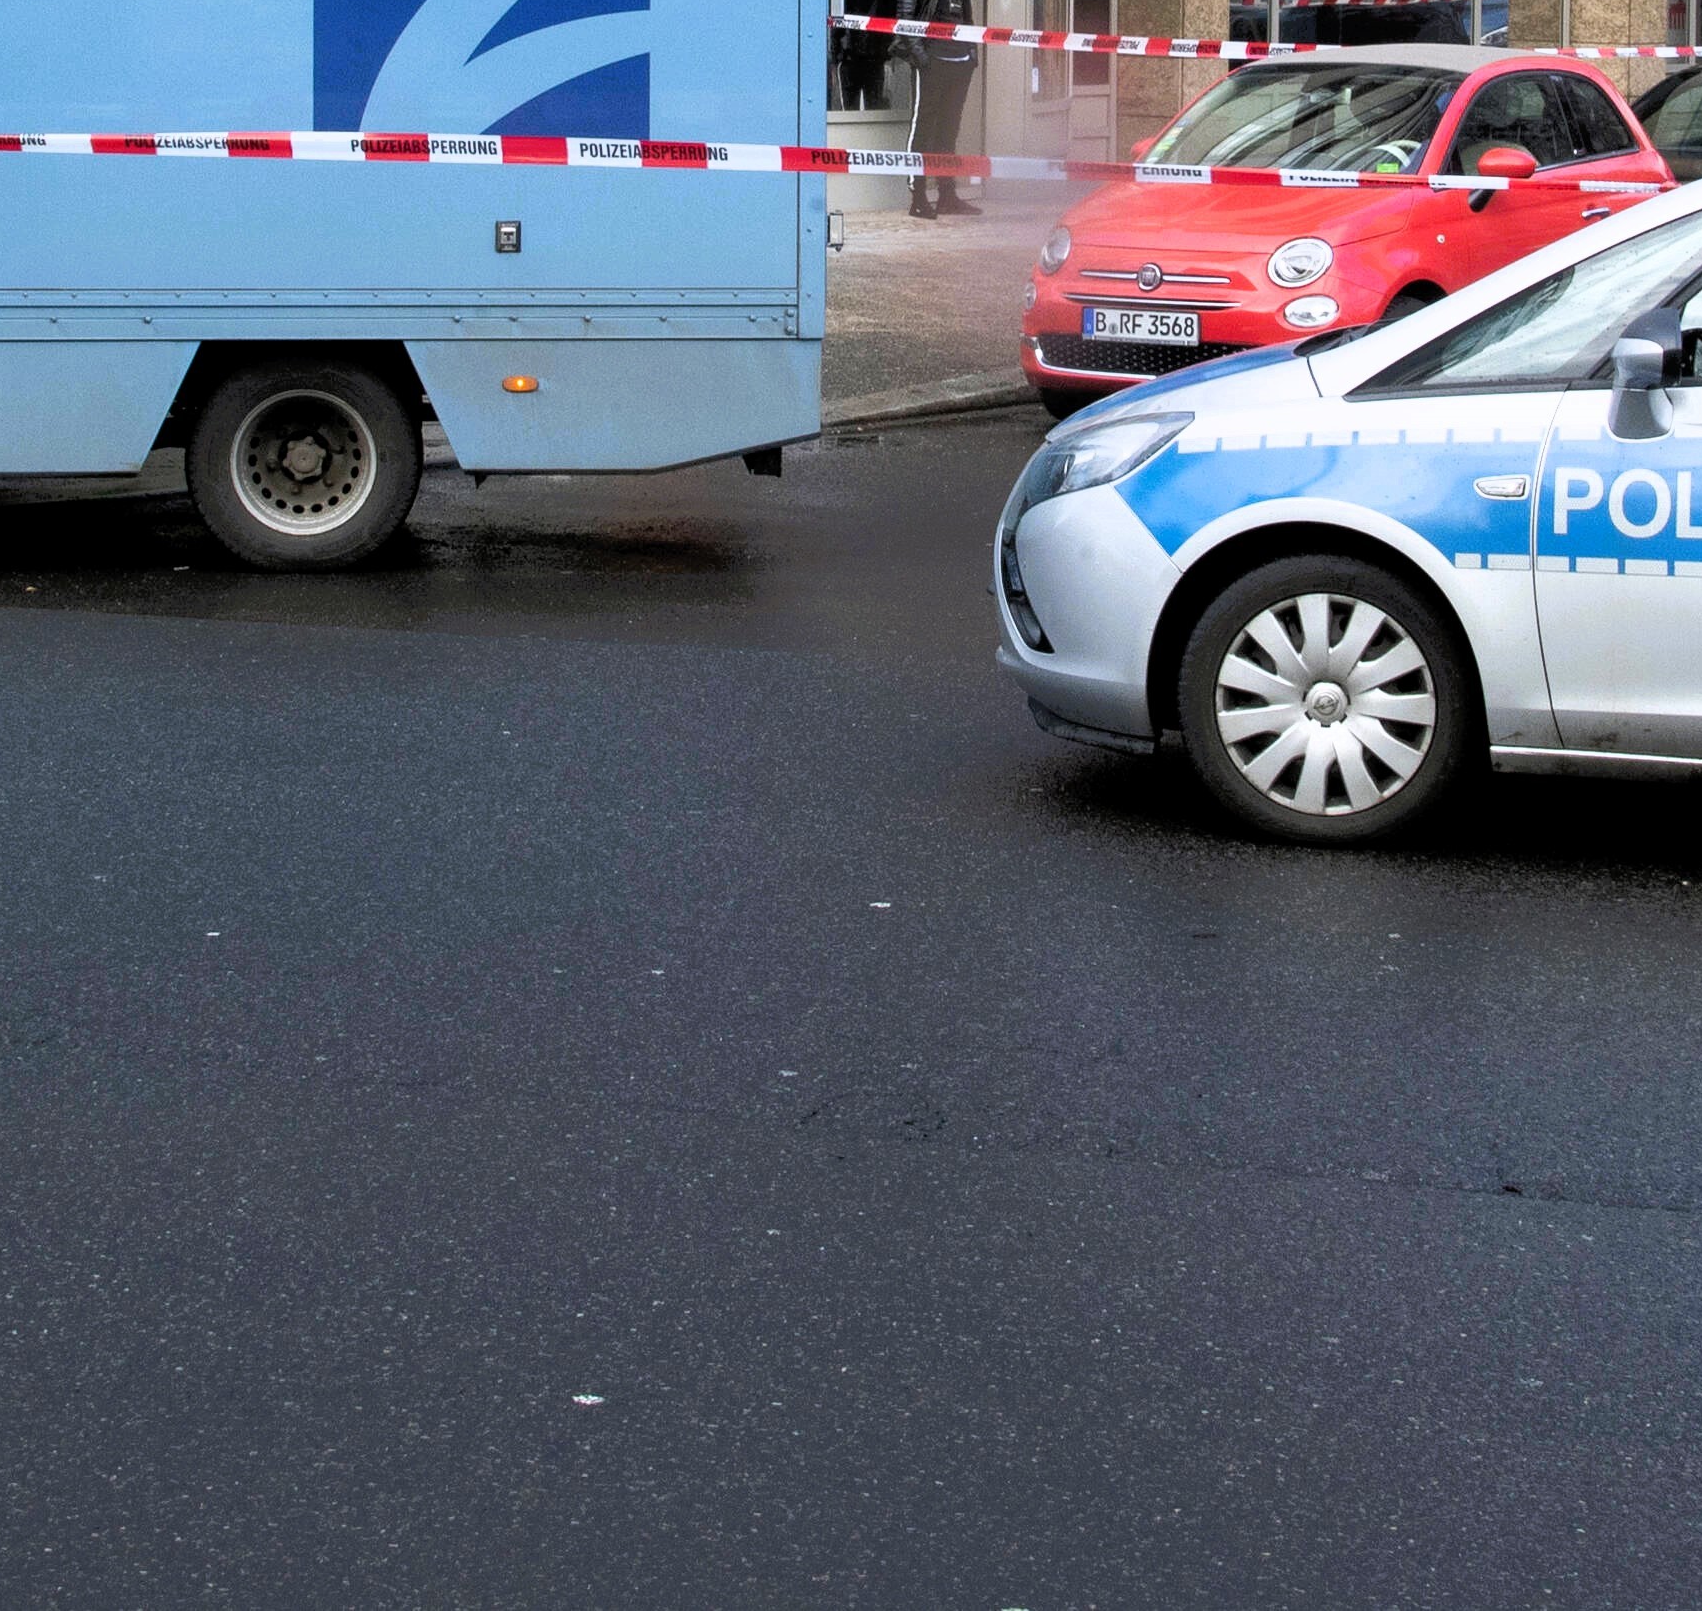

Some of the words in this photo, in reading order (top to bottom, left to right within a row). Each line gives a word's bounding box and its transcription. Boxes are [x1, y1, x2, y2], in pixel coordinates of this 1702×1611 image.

[351, 138, 498, 156] POLIZEIABSPERRUNG
[579, 142, 728, 162] POLIZEIABSPERRUNG
[1095, 311, 1107, 332] B
[1120, 313, 1144, 334] RF
[1147, 314, 1195, 337] 3568
